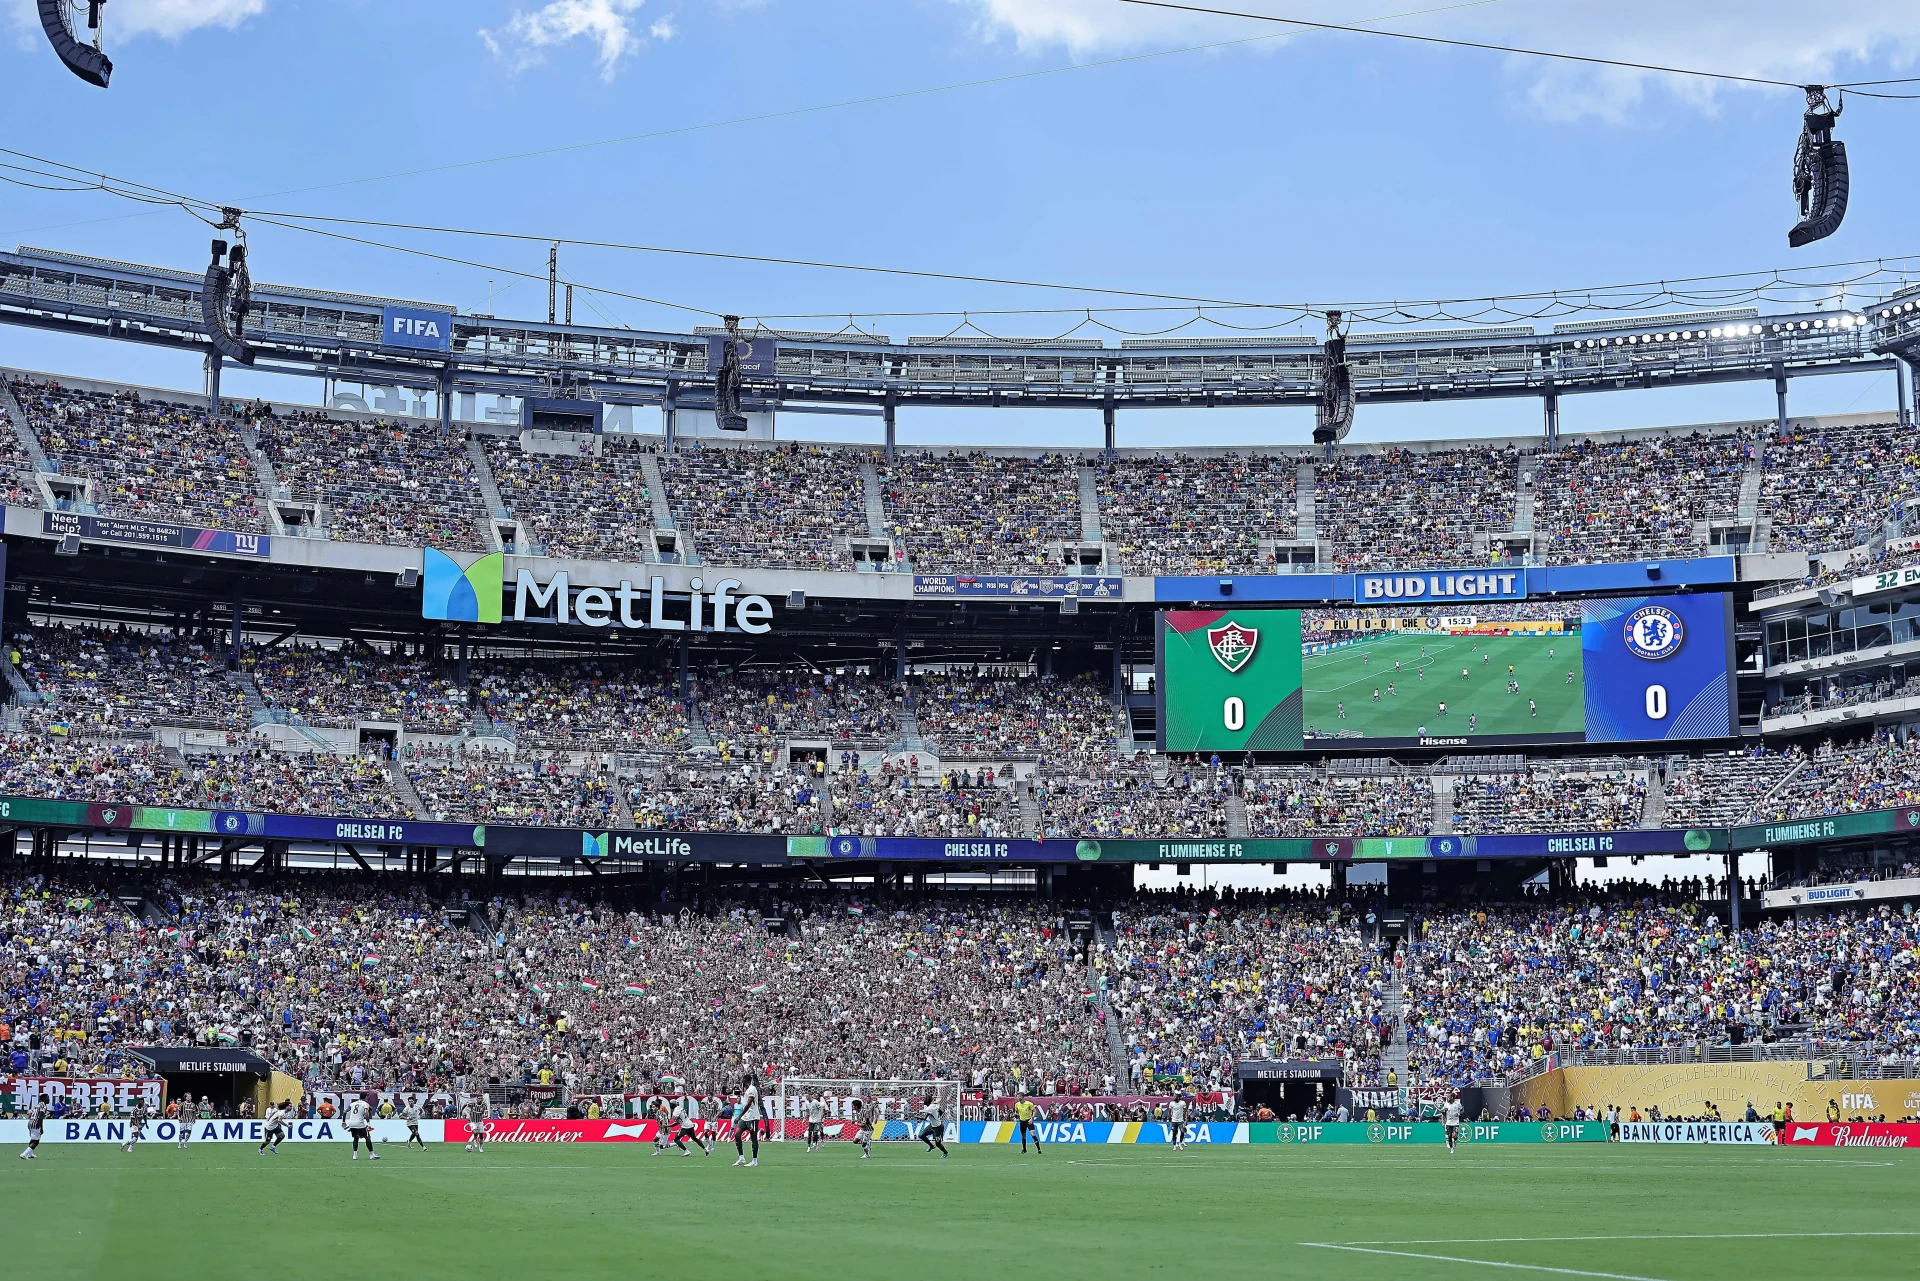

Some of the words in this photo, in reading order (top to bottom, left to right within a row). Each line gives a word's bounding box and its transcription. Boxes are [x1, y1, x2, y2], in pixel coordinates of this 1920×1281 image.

[393, 317, 440, 338] FIFA
[51, 513, 79, 524] Need
[96, 521, 110, 529] Text
[51, 523, 82, 534] Help?
[109, 529, 123, 537] Call
[921, 577, 947, 585] WORLD
[1364, 577, 1426, 598] BUD
[914, 585, 955, 593] CHAMPIONS
[513, 568, 774, 634] MetLife
[1633, 608, 1671, 620] CHELSEA
[1334, 620, 1349, 630] FLU
[1402, 618, 1418, 628] CHE
[1448, 617, 1472, 625] 15:23
[1645, 684, 1667, 719] 0
[1224, 696, 1245, 731] 0
[1420, 737, 1467, 746] Hisense
[167, 812, 175, 824] V
[336, 822, 385, 839] CHELSEA
[388, 824, 403, 840] FC
[1765, 823, 1821, 843] FLUMINENSE
[1823, 821, 1835, 836] FC
[615, 837, 691, 856] MetLife
[944, 843, 990, 857] CHELSEA
[994, 843, 1008, 857] FC
[1159, 843, 1226, 858] FLUMINENSE
[1229, 843, 1242, 858] FC
[1386, 841, 1393, 856] V
[1548, 837, 1595, 853] CHELSEA
[1599, 836, 1613, 852] FC
[1808, 891, 1826, 900] BUD
[1827, 888, 1851, 898] LIGHT
[179, 1061, 211, 1071] METLIFE
[213, 1062, 246, 1072] STADIUM
[1257, 1069, 1288, 1079] METLIFE
[1289, 1069, 1321, 1079] STADIUM
[1842, 1094, 1874, 1109] FIFA
[353, 1104, 359, 1115] 8
[202, 1121, 334, 1141] AMEICA
[464, 1122, 584, 1143] Budweiser
[1033, 1122, 1087, 1143] VISA
[1297, 1126, 1323, 1141] PIF
[1387, 1126, 1413, 1140] PIF
[1474, 1126, 1500, 1140] PIF
[1560, 1125, 1585, 1139] PIF
[1623, 1124, 1661, 1141] BANK
[1664, 1124, 1682, 1141] OF
[1687, 1124, 1753, 1142] AMERICA
[1831, 1125, 1908, 1148] Budweiser
